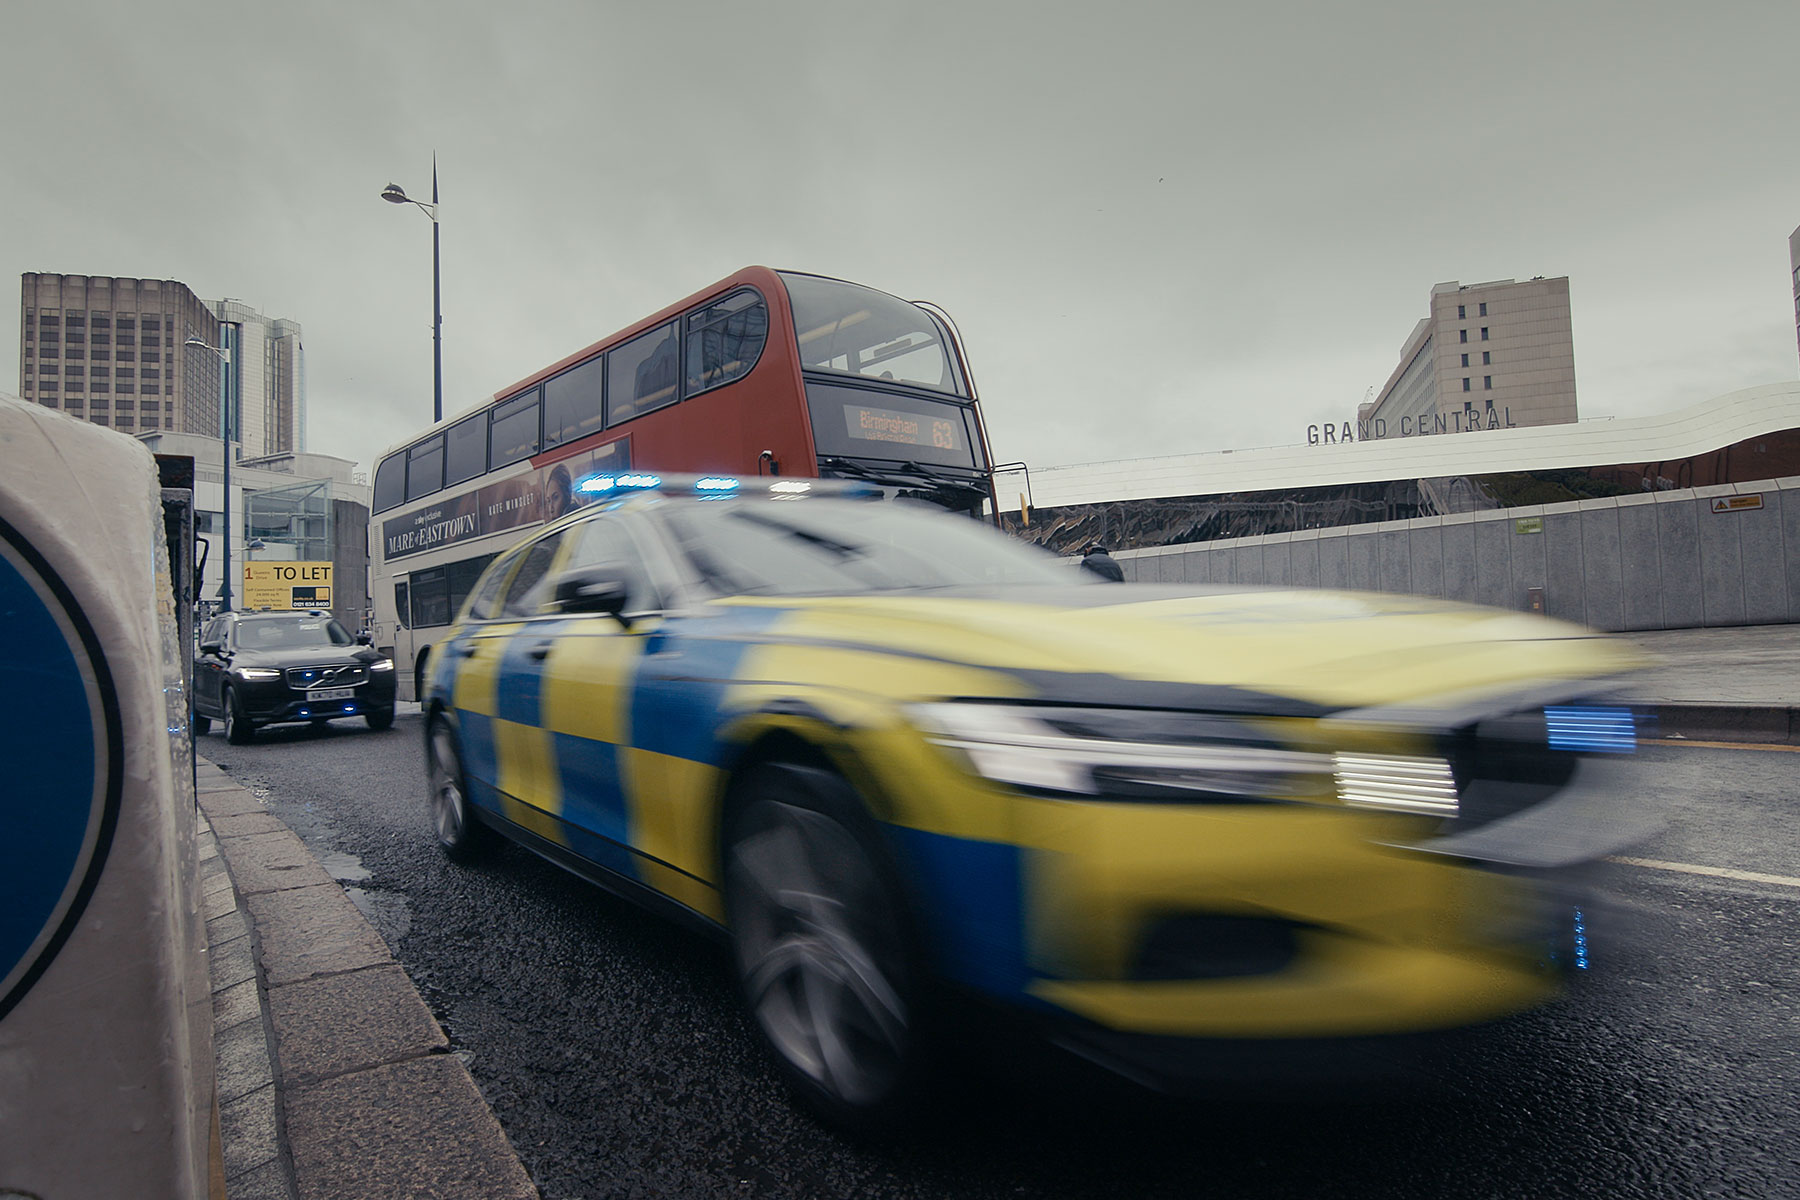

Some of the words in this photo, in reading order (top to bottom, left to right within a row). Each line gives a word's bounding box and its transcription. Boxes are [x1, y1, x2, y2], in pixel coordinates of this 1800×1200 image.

[859, 410, 919, 435] Birmingham
[933, 421, 953, 449] 63
[1307, 419, 1387, 445] GRAND
[1401, 407, 1516, 436] CENTRAL
[488, 502, 503, 516] KATE
[505, 493, 534, 511] WINSLET
[388, 531, 415, 554] MARE
[419, 513, 476, 545] EASTTOWN
[245, 567, 253, 580] 1
[273, 566, 297, 580] TO
[302, 567, 331, 580] LET
